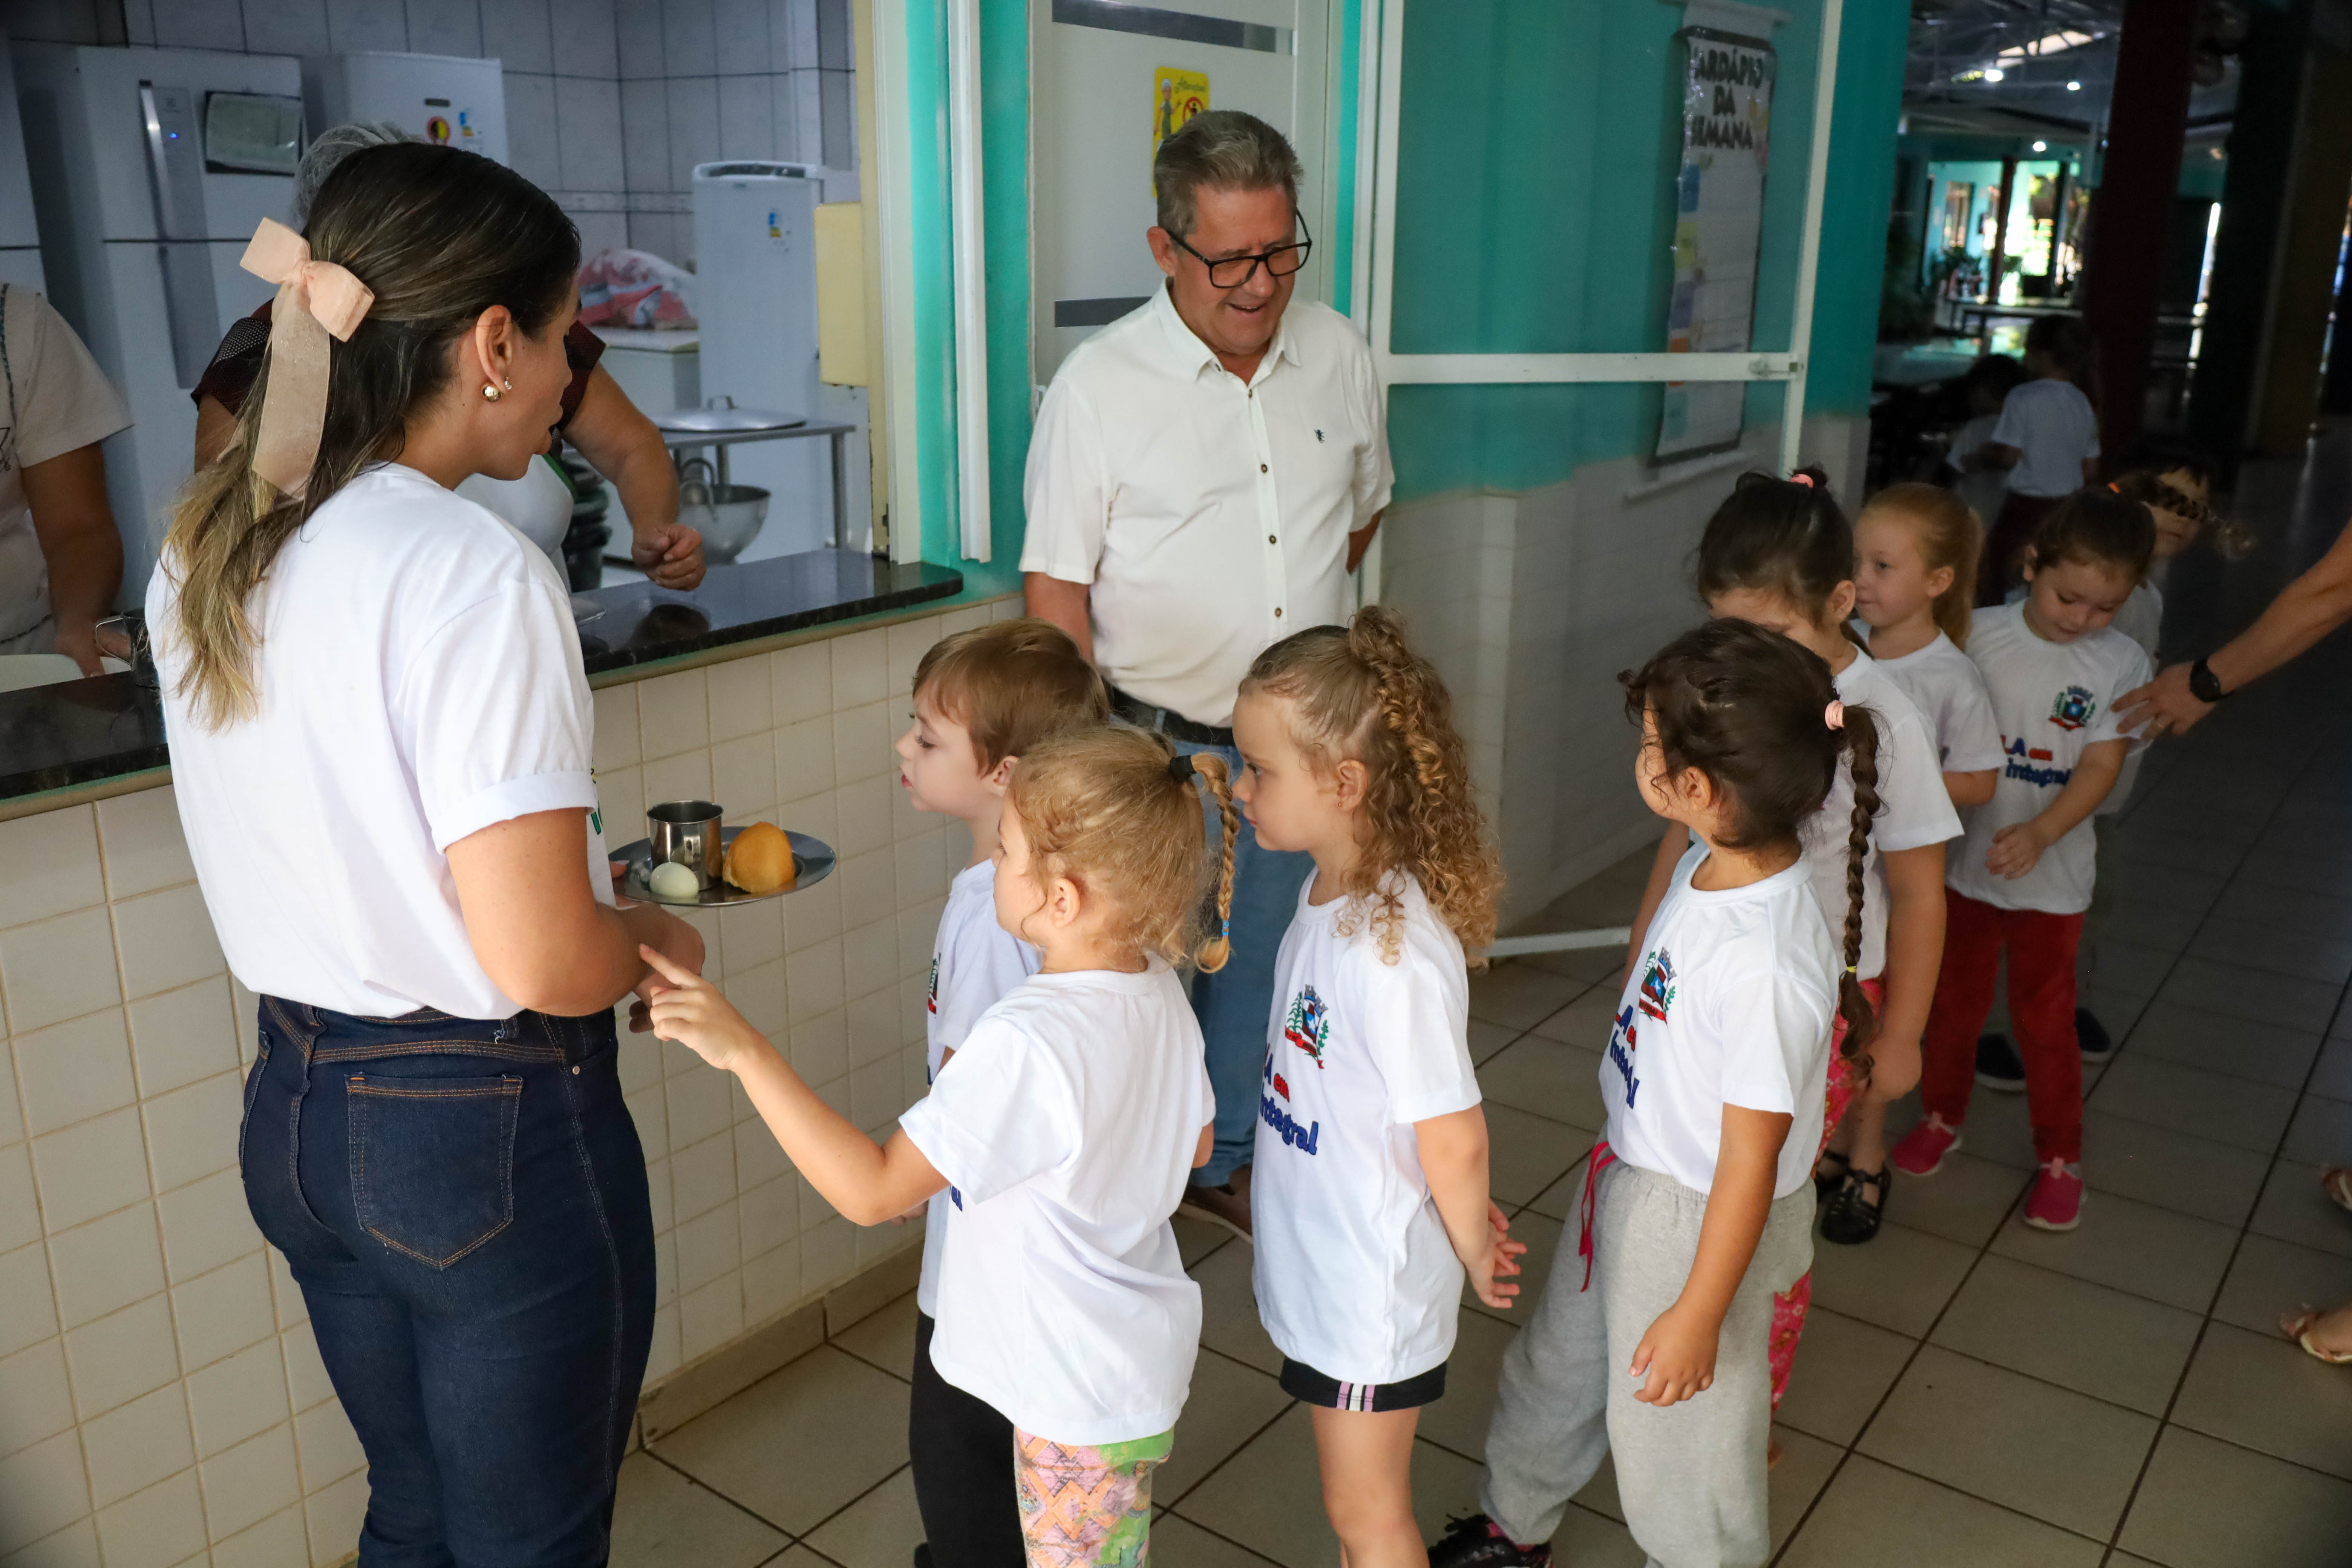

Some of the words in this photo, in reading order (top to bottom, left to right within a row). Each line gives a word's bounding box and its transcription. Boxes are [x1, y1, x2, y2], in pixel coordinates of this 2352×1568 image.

[1713, 85, 1735, 115] DA
[2029, 747, 2053, 762] em
[1274, 1073, 1290, 1103] em
[1260, 1081, 1318, 1155] Integral
